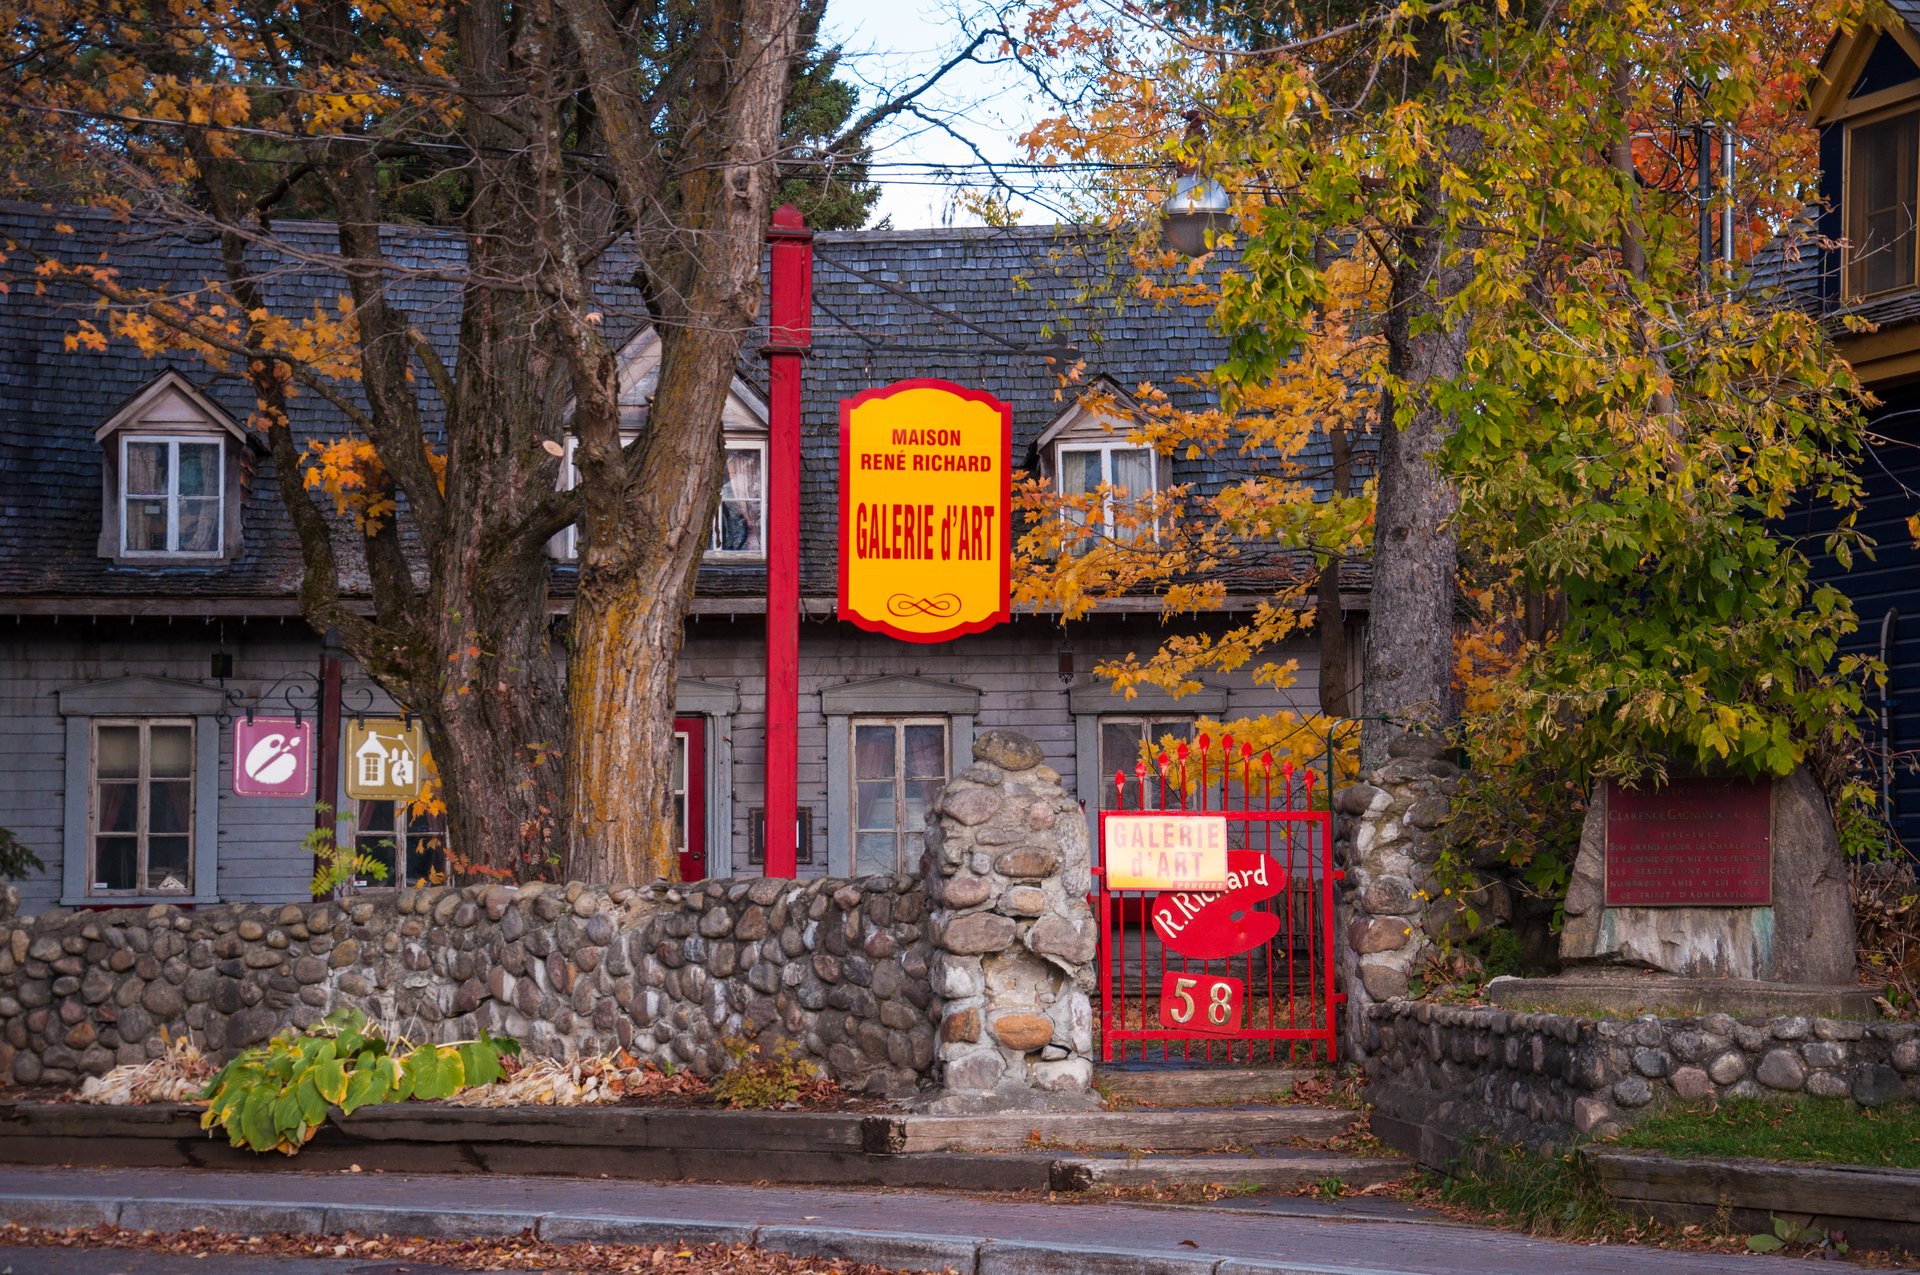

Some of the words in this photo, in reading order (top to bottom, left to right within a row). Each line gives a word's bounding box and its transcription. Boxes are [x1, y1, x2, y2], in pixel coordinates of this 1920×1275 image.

[892, 429, 961, 446] MAISON
[861, 450, 906, 471] RENÉ
[913, 454, 992, 472] RICHARD
[856, 502, 934, 560] GALERIE
[941, 504, 995, 561] d'ART
[1113, 822, 1219, 849] GALERIE
[1131, 851, 1203, 878] d'ART
[1177, 882, 1224, 890] POUSSEZ
[1170, 977, 1232, 1026] 58
